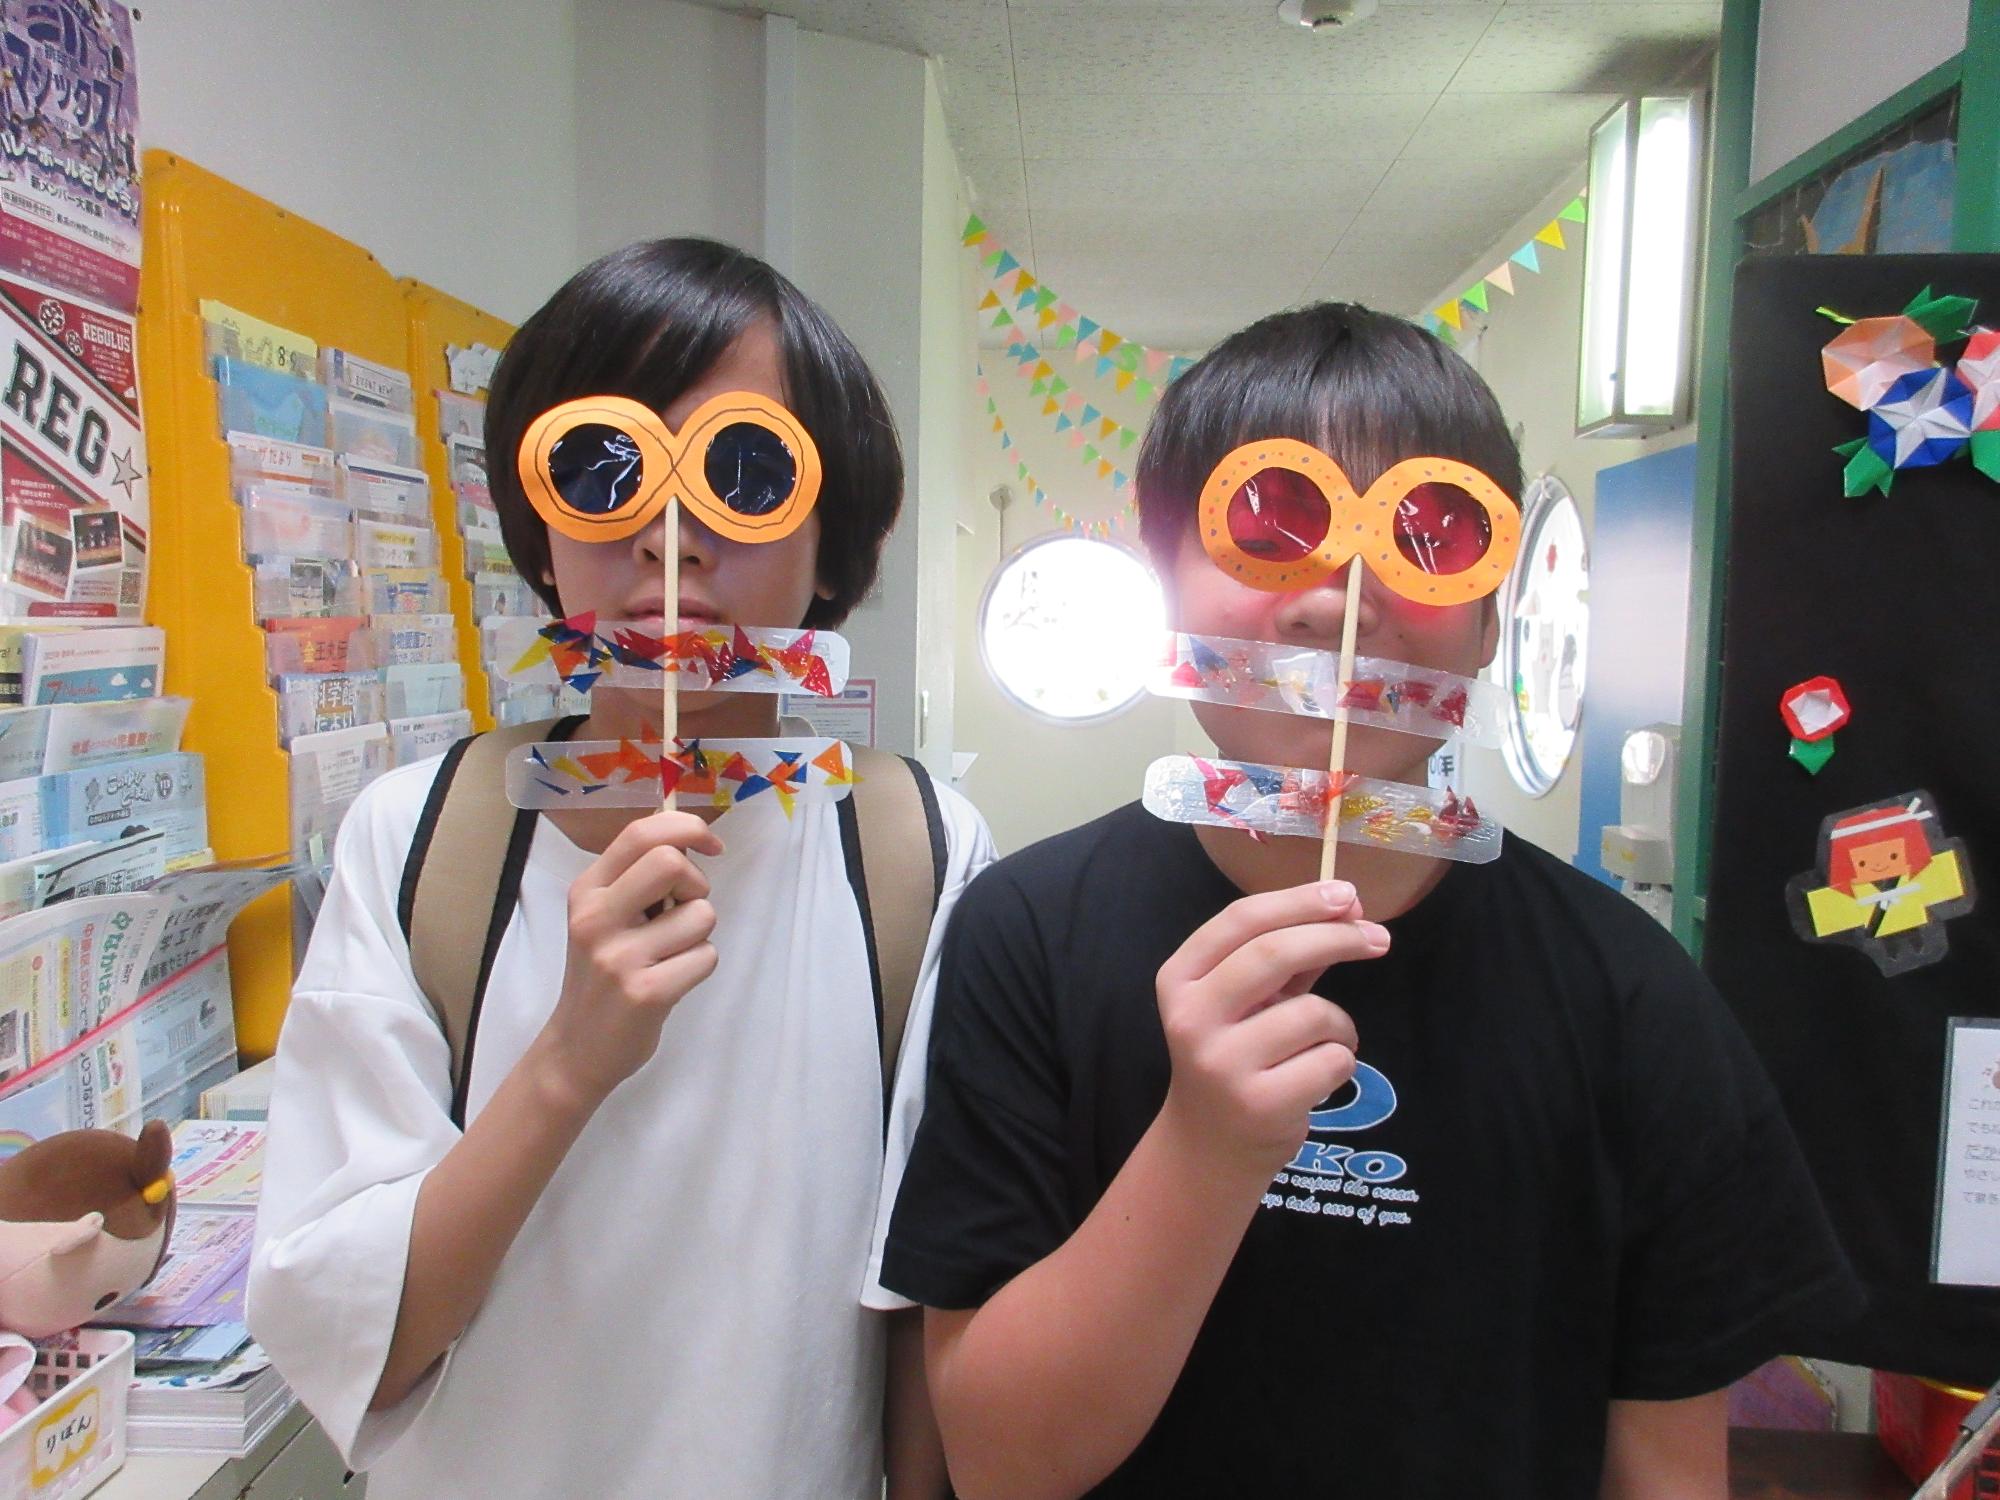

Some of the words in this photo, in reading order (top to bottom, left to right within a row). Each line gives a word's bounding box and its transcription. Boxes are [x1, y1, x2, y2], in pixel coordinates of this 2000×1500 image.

[83, 322, 130, 353] REGULUS
[2, 339, 111, 479] REG
[1291, 1174, 1342, 1193] respect
[1343, 1179, 1369, 1197] the
[1285, 1196, 1320, 1213] take
[1322, 1204, 1354, 1217] care
[1357, 1204, 1377, 1225] of
[1378, 1210, 1411, 1226] you.
